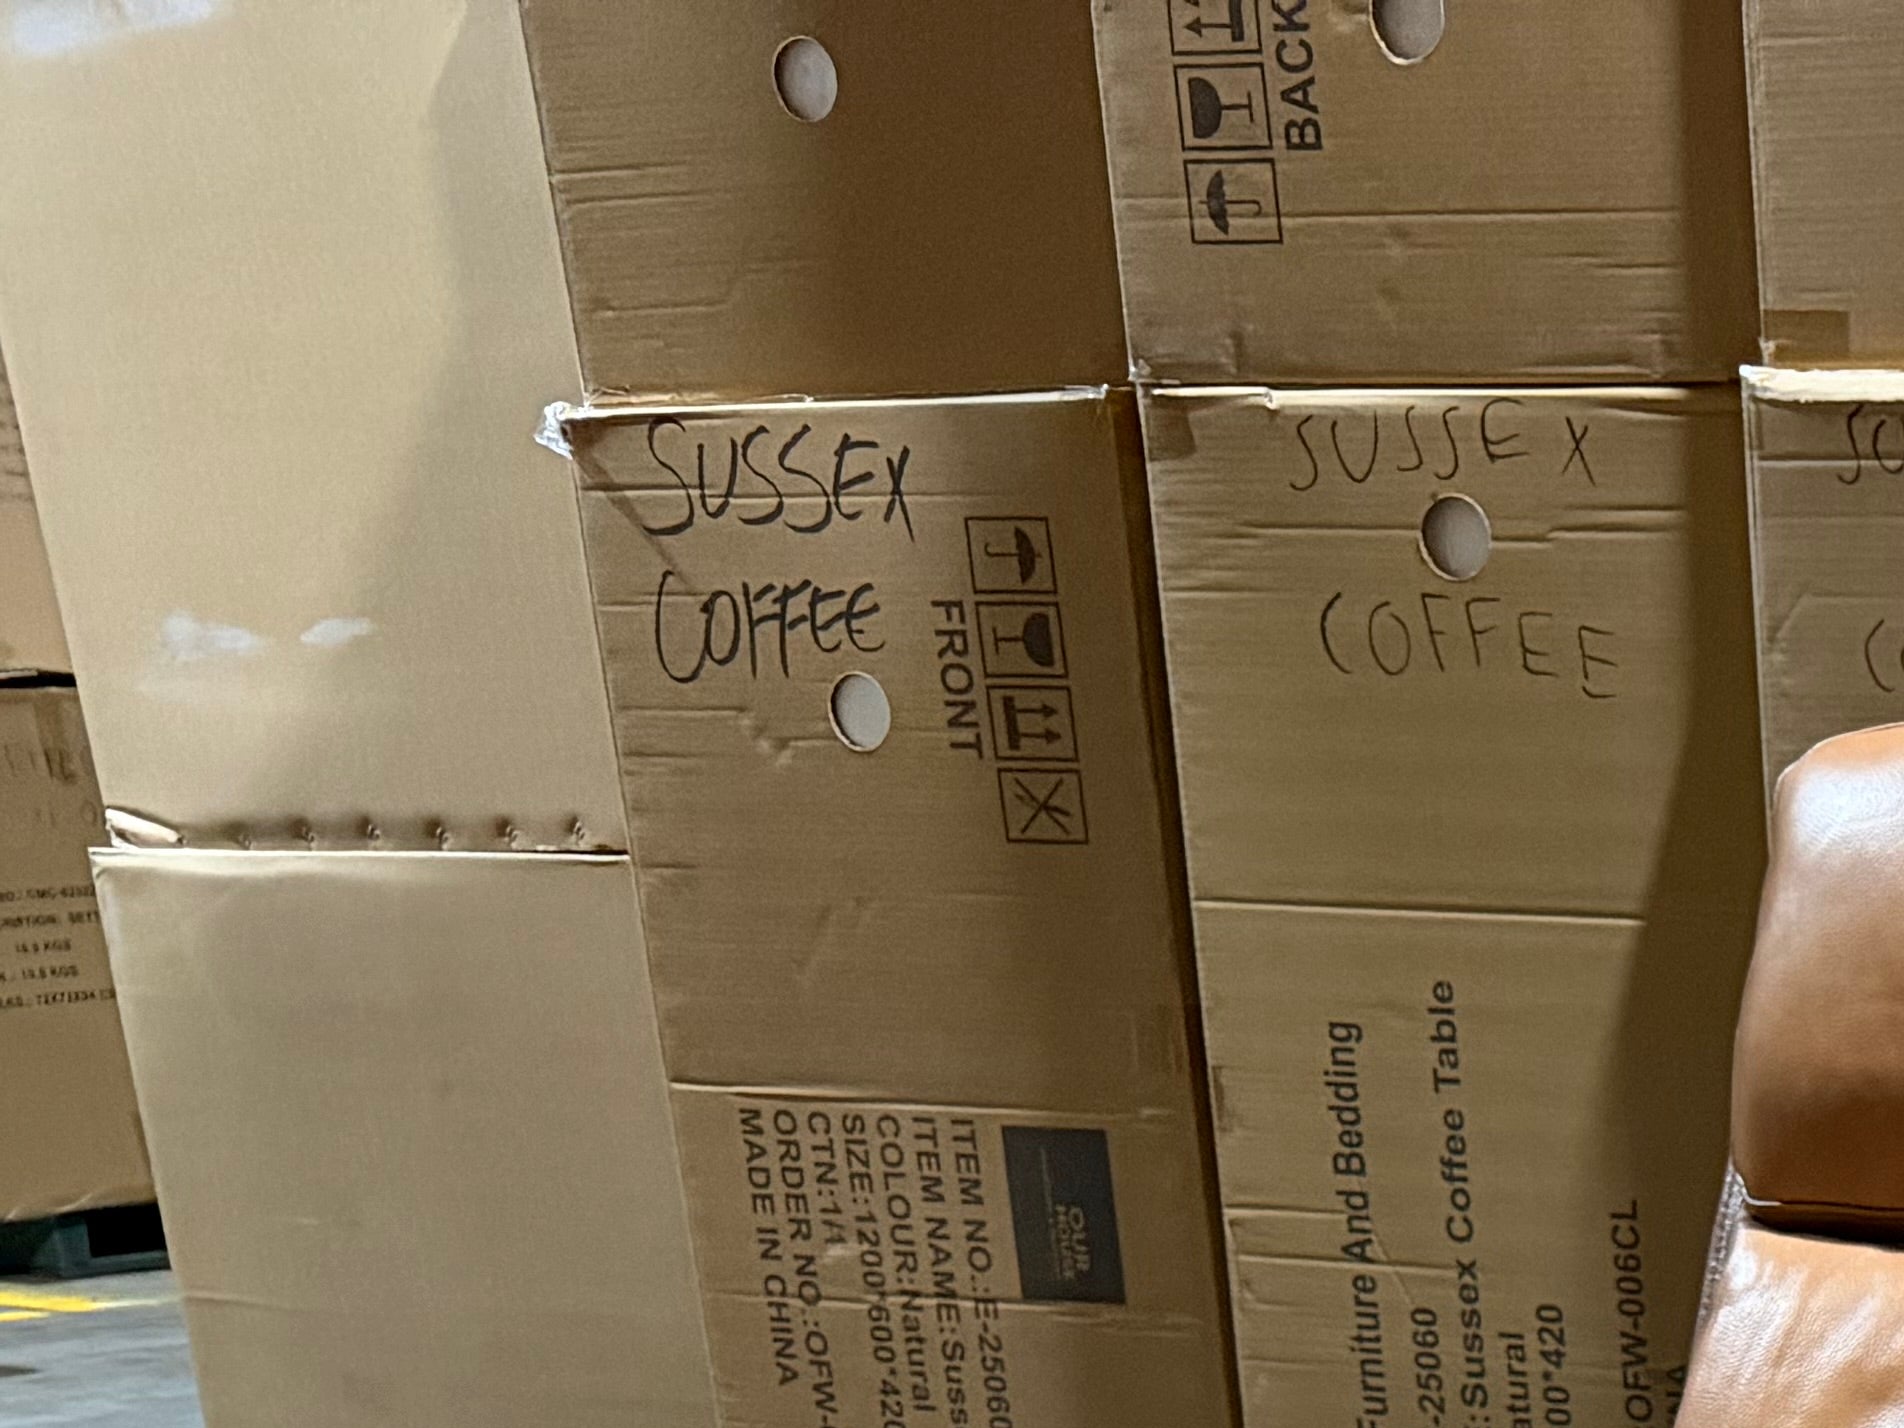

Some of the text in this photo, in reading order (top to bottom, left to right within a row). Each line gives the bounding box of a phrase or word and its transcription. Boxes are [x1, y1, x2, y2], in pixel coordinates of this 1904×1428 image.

[1273, 0, 1324, 152] BACK
[643, 416, 914, 542] SUSSEX
[1289, 398, 1597, 492] SUSSEX
[655, 570, 886, 684] COFFEE
[931, 600, 984, 759] FRONT
[1320, 593, 1618, 699] COFFEE
[1322, 1020, 1368, 1178] Bedding
[1427, 979, 1461, 1096] Table
[773, 1109, 813, 1241] ORDER
[910, 1116, 943, 1207] ITEM
[950, 1118, 983, 1212] ITEM
[1439, 1106, 1475, 1244] Coffee
[739, 1107, 799, 1386] MADE IN CHINA
[876, 1114, 936, 1412] COLOUR:Natural
[1342, 1189, 1374, 1265] And
